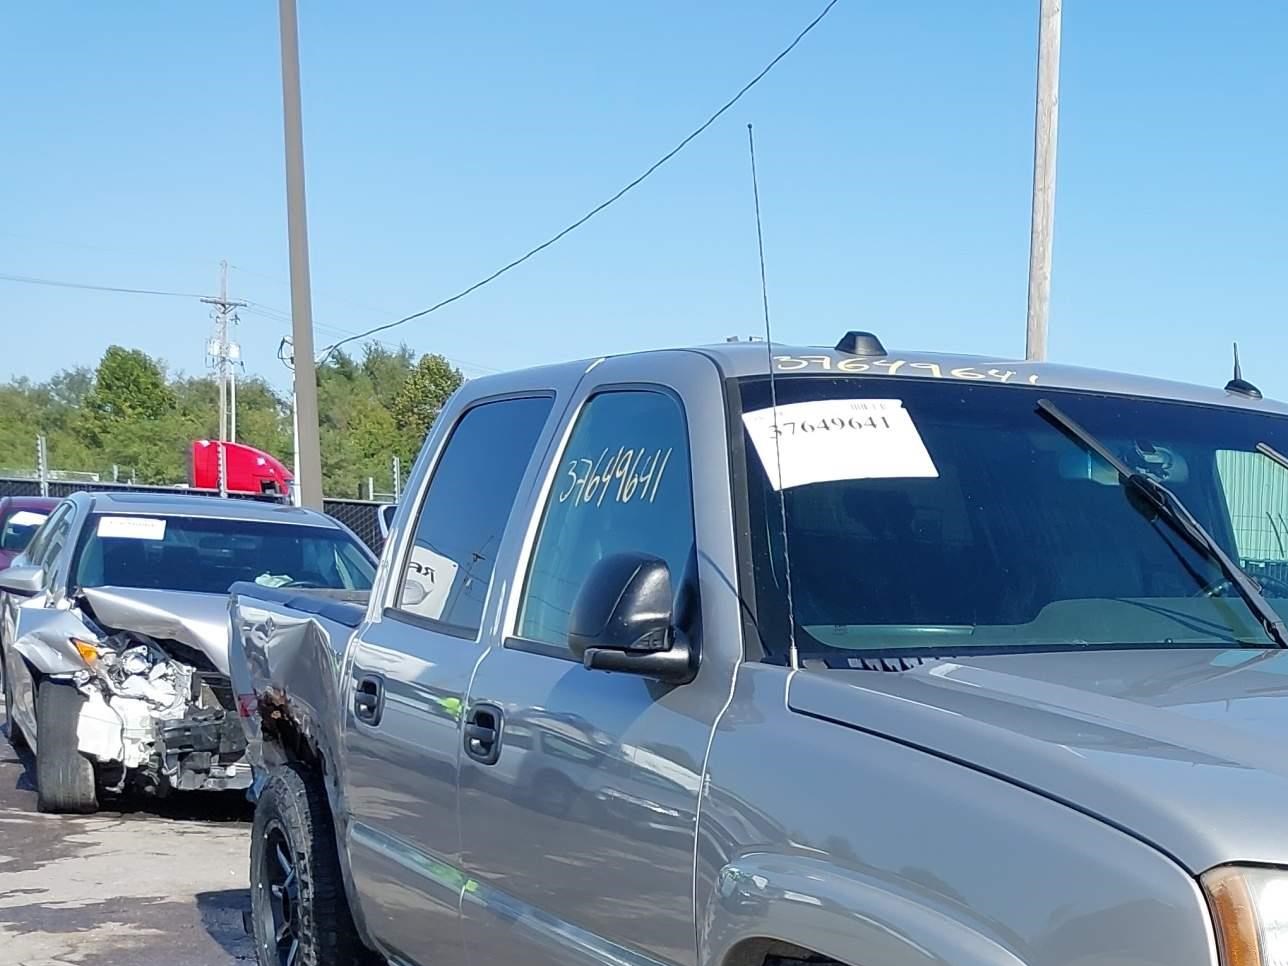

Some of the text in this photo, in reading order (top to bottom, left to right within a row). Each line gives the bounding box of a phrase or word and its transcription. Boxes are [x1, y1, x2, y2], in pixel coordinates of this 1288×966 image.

[773, 355, 1039, 384] 37649641
[768, 416, 890, 439] 37649641
[560, 446, 672, 508] 37649641
